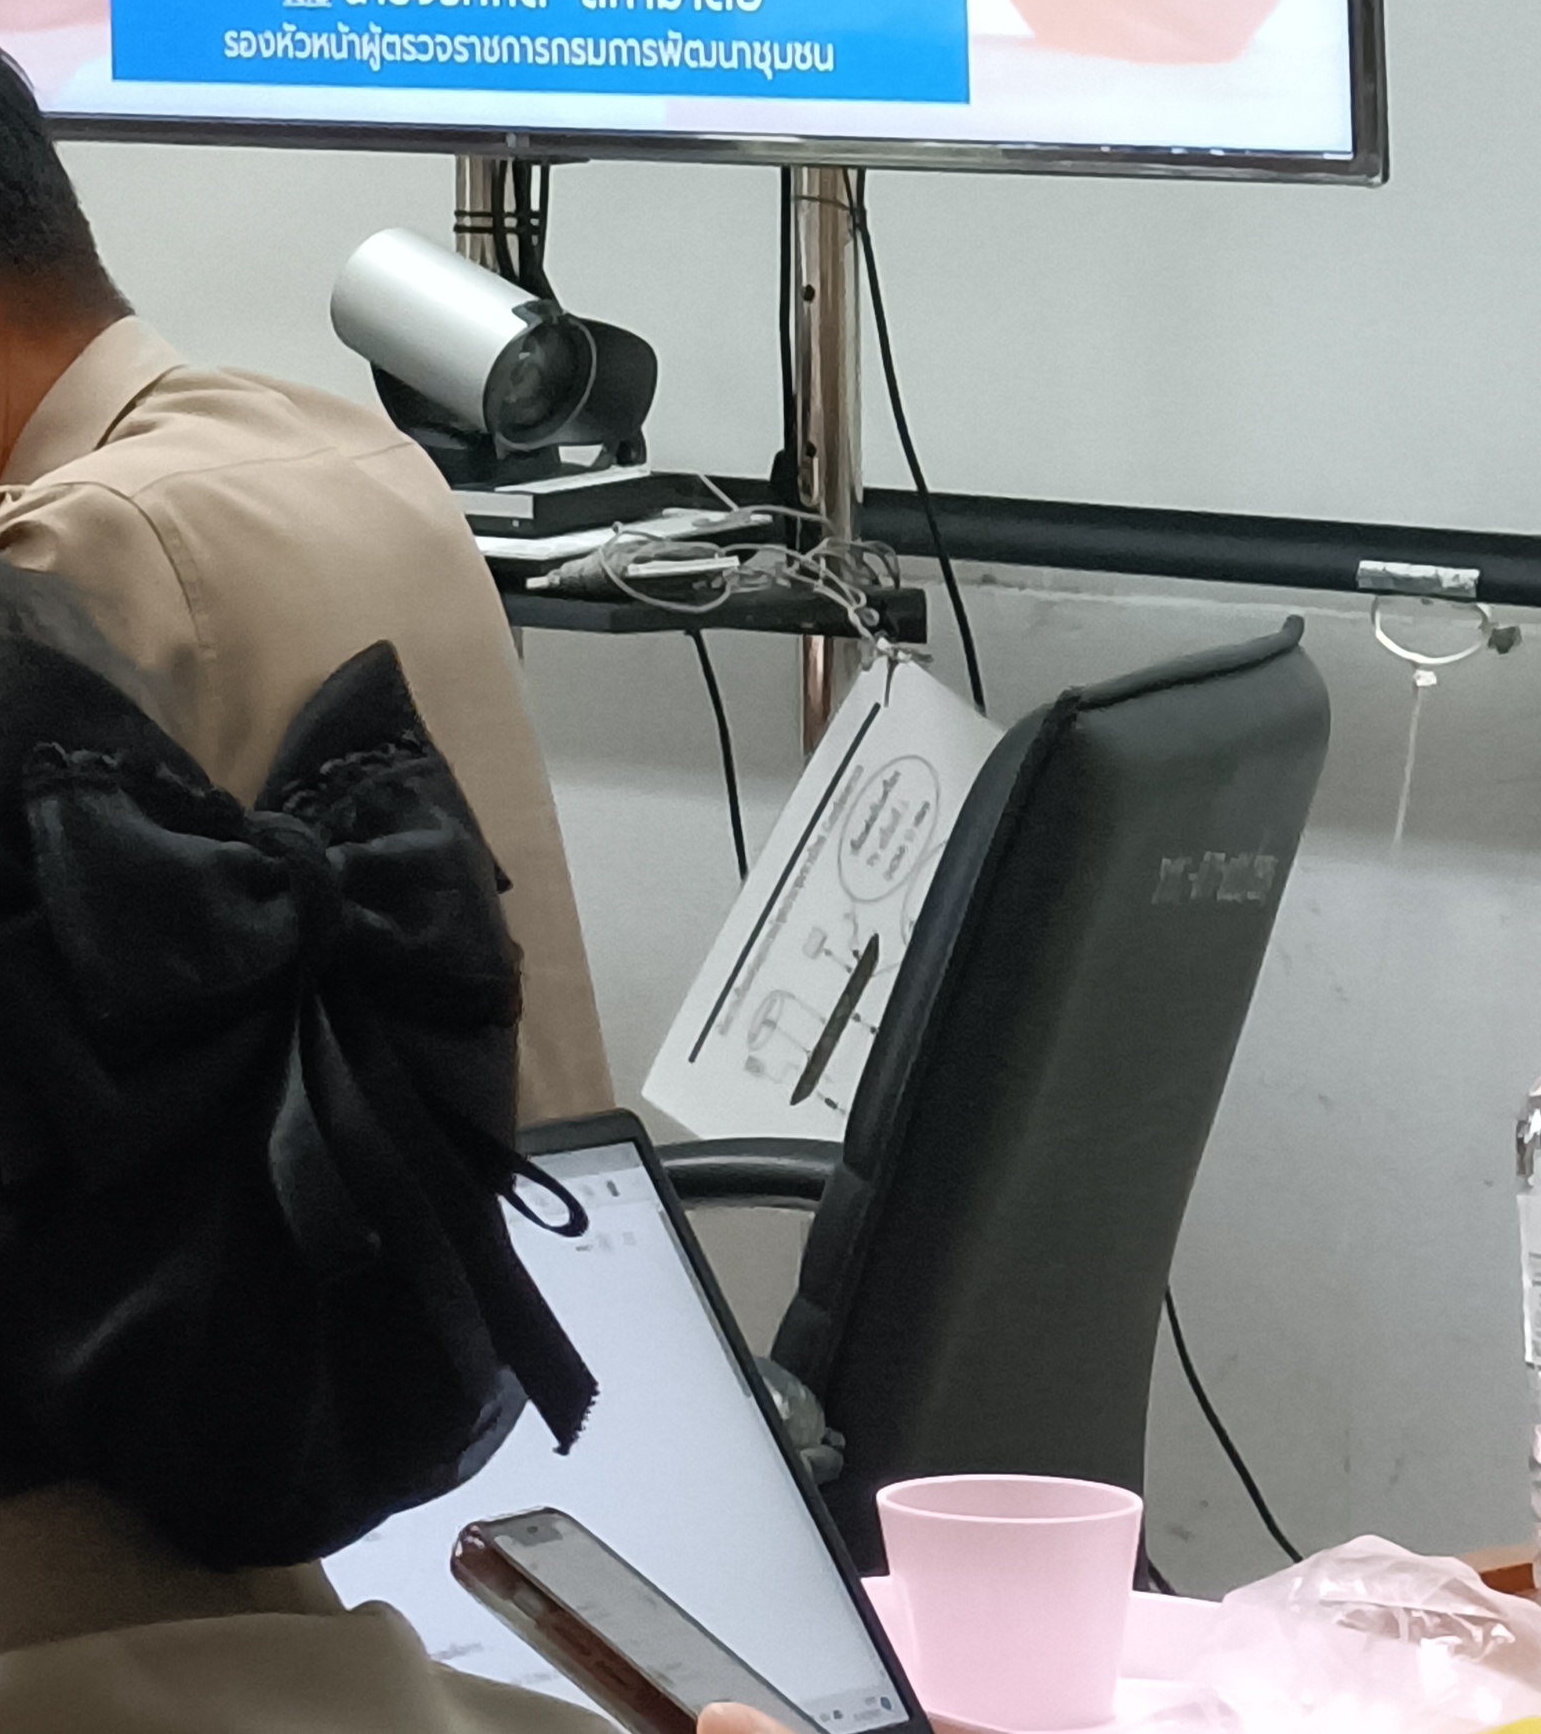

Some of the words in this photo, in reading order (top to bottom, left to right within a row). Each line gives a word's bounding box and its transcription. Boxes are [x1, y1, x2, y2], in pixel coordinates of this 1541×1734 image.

[223, 20, 835, 80] รองหัวหน้าผู้ตรวจราชการกรมการพัฒนาชุมชน
